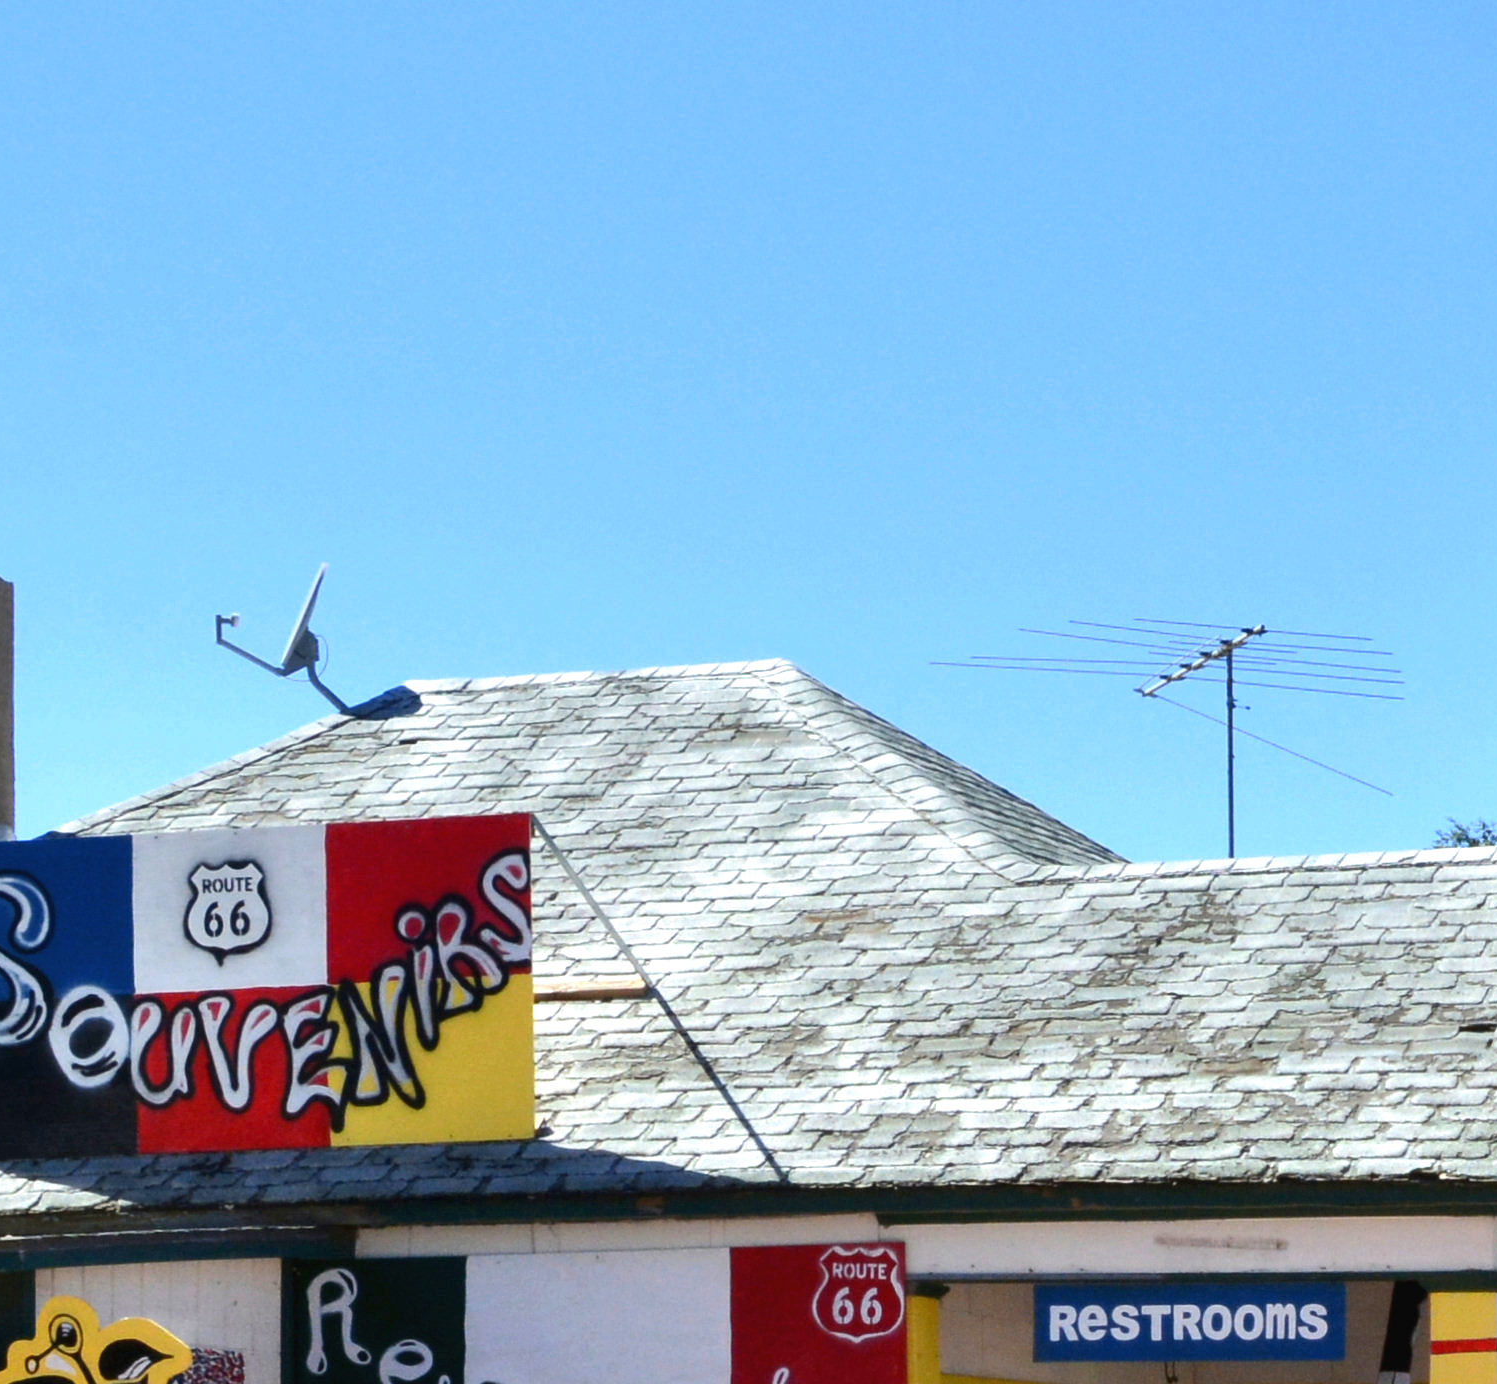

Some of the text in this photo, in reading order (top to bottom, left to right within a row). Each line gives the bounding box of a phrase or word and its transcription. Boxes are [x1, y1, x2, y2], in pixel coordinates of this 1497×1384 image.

[202, 876, 254, 895] ROUTE
[203, 901, 251, 939] 66
[831, 1261, 888, 1282] ROUTE
[831, 1289, 883, 1326] 66
